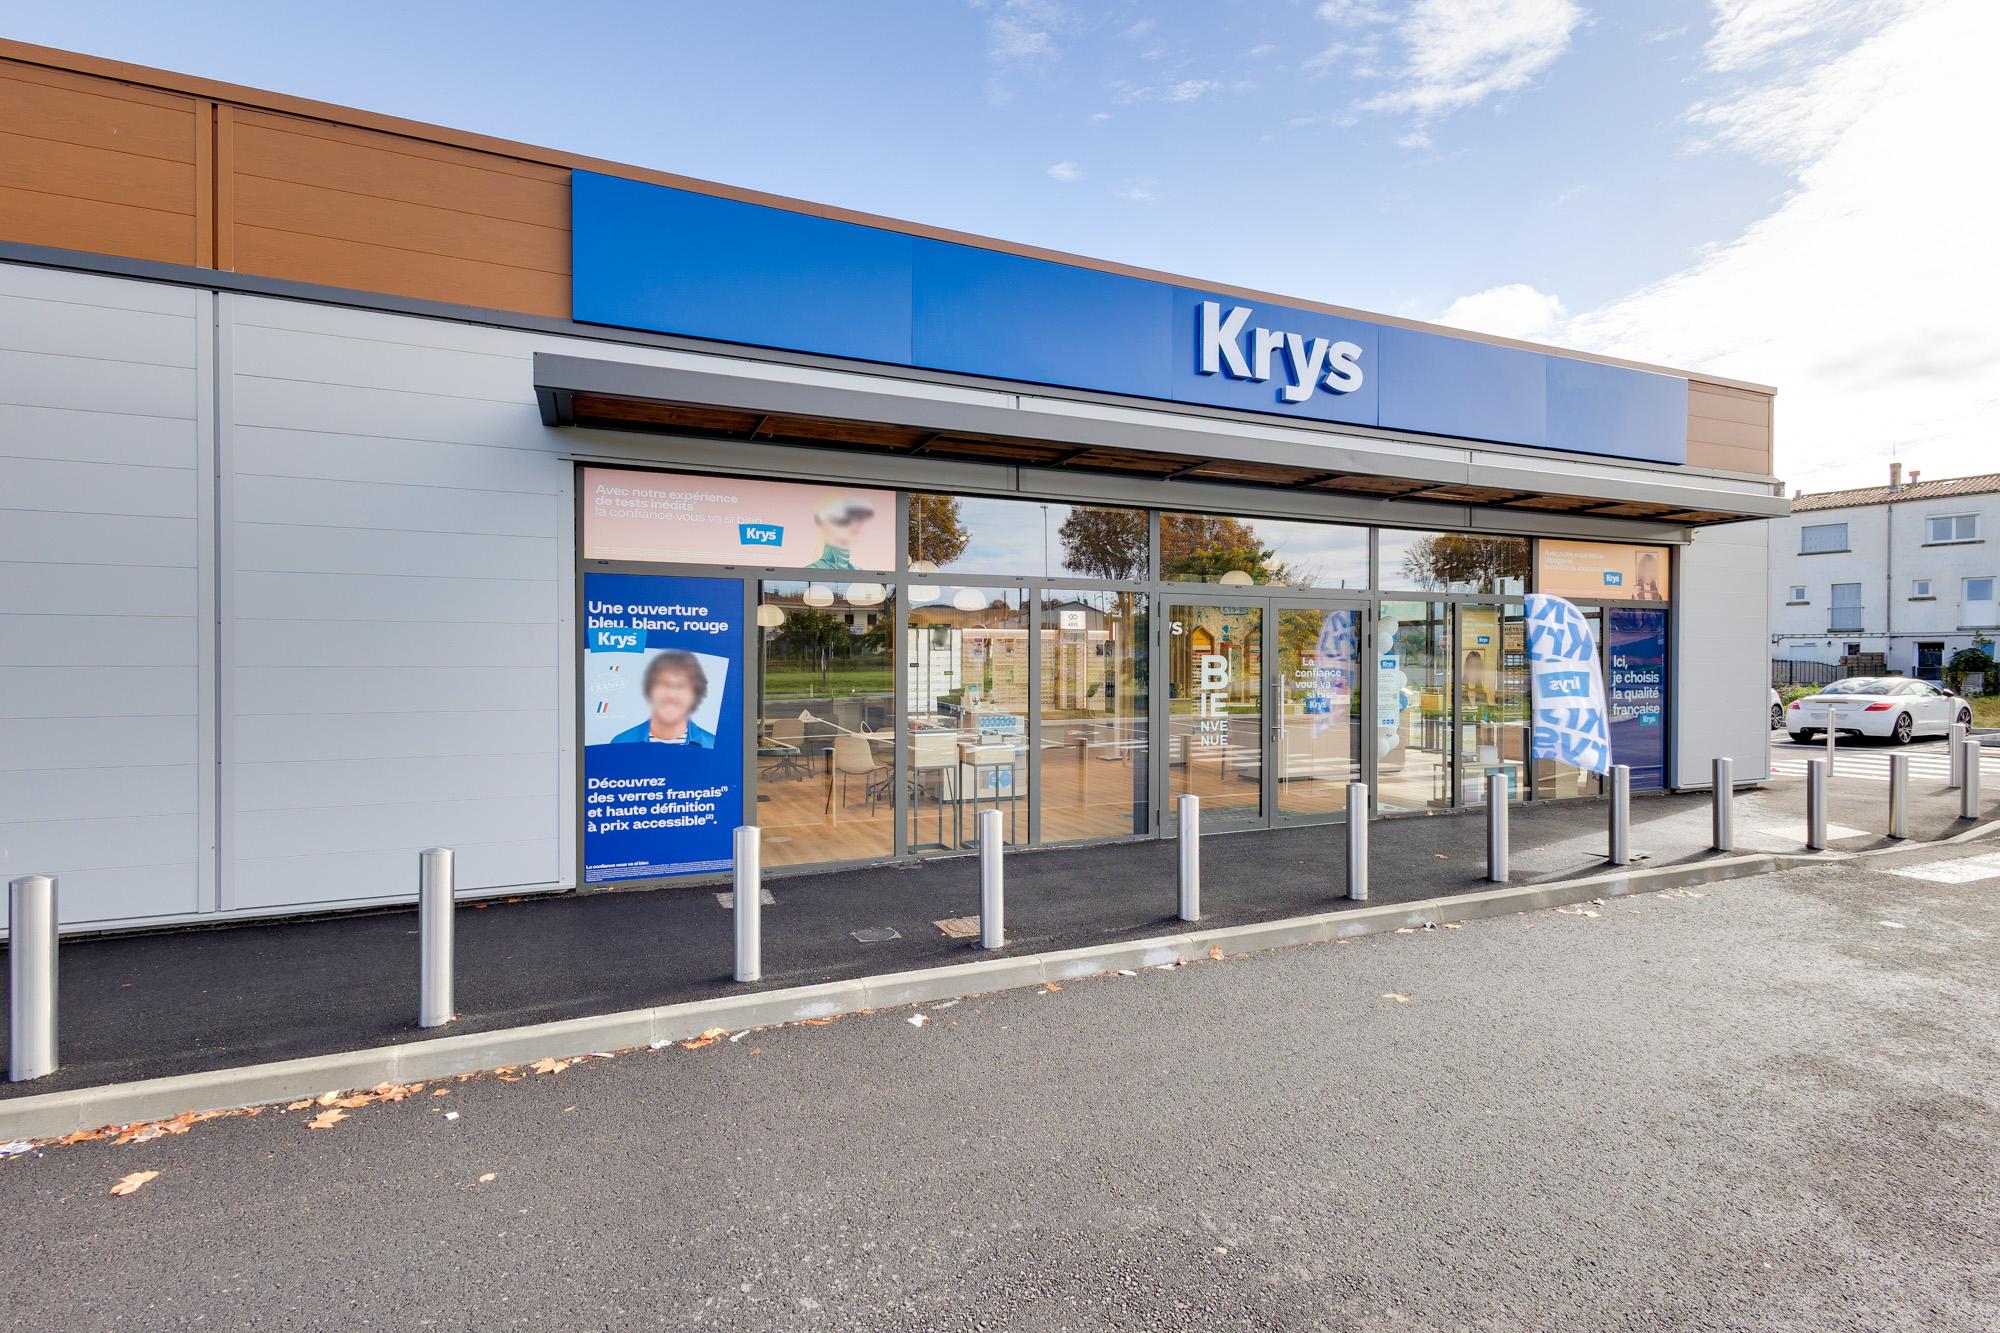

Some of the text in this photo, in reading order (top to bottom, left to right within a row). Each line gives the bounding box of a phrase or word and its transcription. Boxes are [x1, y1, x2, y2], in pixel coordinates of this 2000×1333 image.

[1198, 300, 1364, 402] Krys
[595, 484, 738, 504] Avec notre expérience
[595, 495, 613, 507] de
[615, 497, 648, 509] tests
[594, 506, 606, 517] la
[609, 508, 673, 520] confiance
[676, 512, 705, 523] vous
[708, 513, 722, 524] va
[725, 512, 734, 524] si
[746, 527, 777, 542] Krys
[588, 600, 709, 617] Une ouverture
[632, 617, 680, 632] blanc,
[683, 621, 729, 634] rouge
[598, 632, 637, 648] Krys
[1302, 657, 1314, 666] La
[1613, 655, 1628, 669] Ici,
[1295, 668, 1342, 678] confiance
[1612, 671, 1660, 687] je choisis
[1295, 681, 1318, 689] vous
[1613, 686, 1659, 702] la qualité
[1310, 700, 1327, 710] Krys
[1613, 703, 1660, 718] française
[1200, 720, 1229, 732] NVE
[1200, 735, 1229, 746] NUE
[588, 777, 666, 789] Découvrez
[587, 792, 615, 804] des
[618, 790, 664, 802] verres
[587, 801, 715, 818] et haute définition
[587, 821, 597, 832] à
[600, 819, 630, 834] prix
